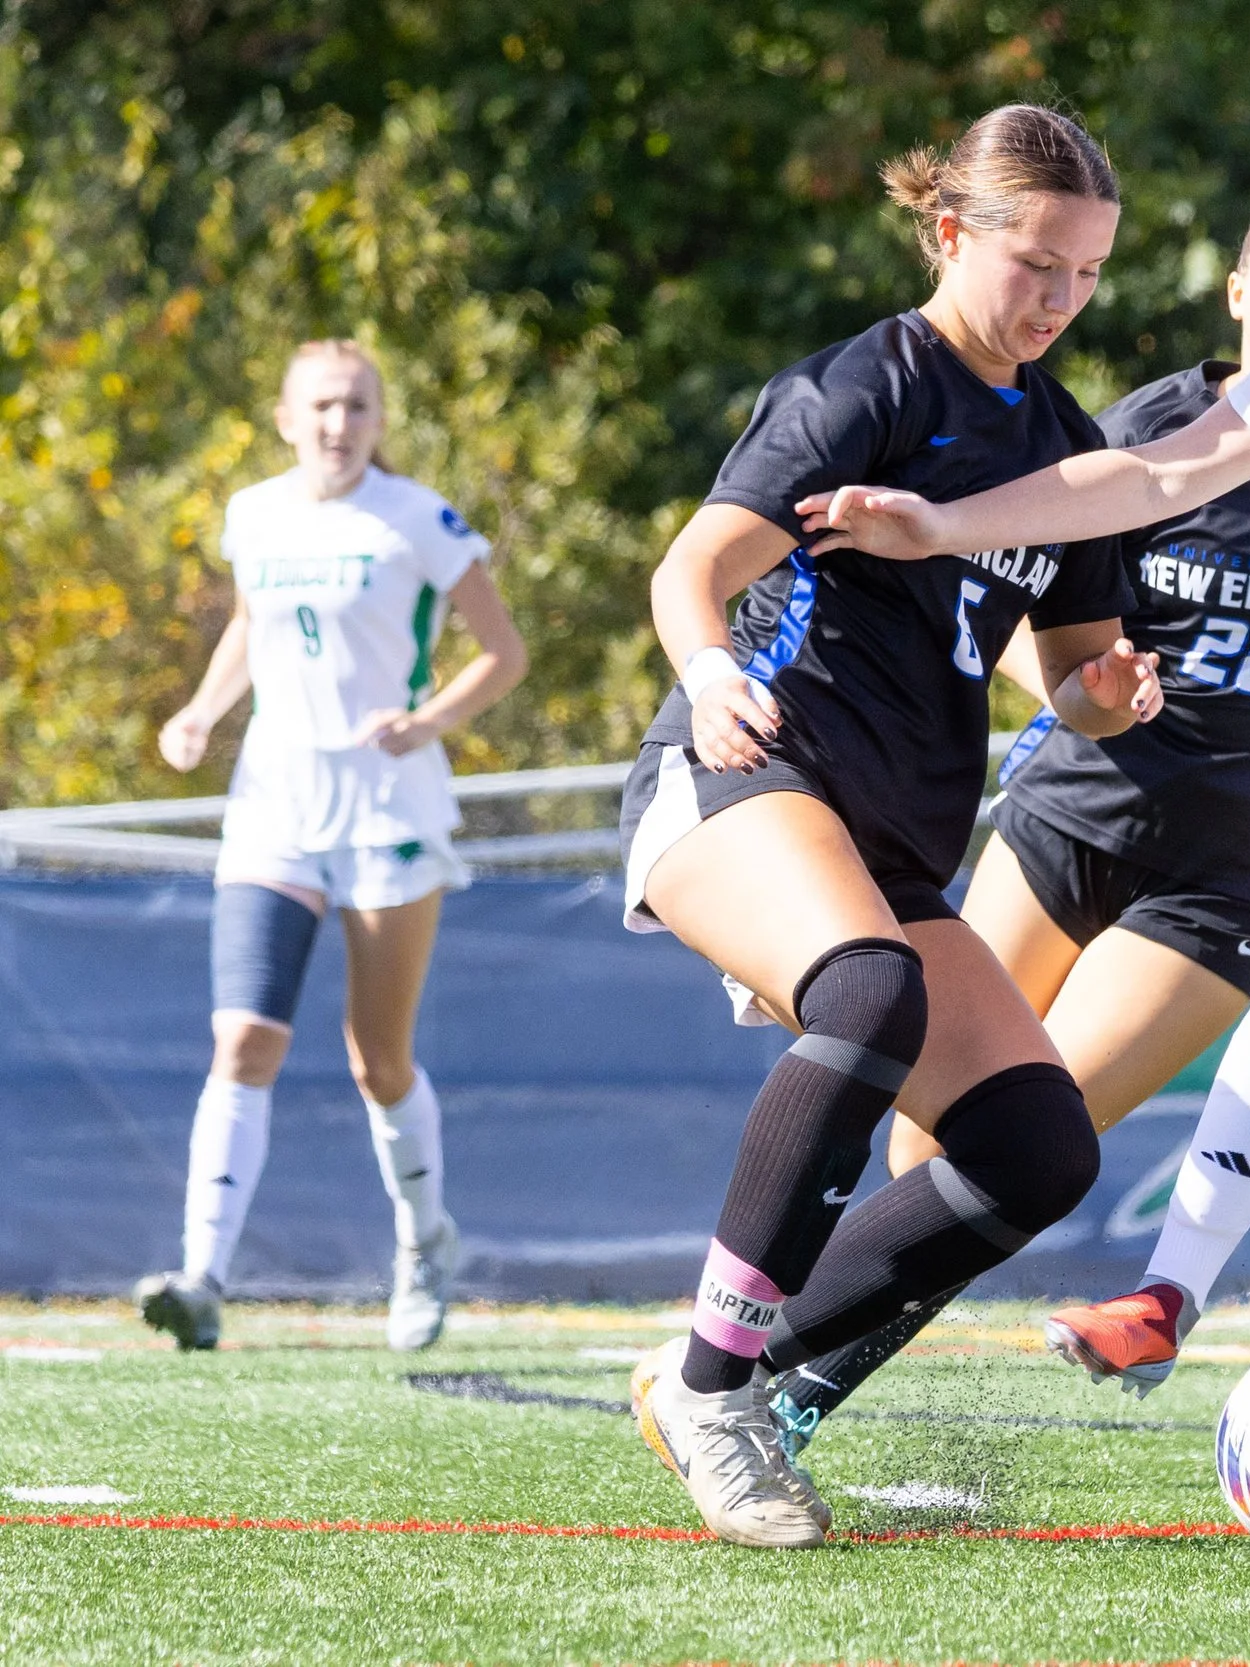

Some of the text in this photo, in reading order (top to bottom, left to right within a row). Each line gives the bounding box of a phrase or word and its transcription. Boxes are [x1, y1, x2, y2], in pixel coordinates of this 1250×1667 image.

[1140, 552, 1216, 603] NEW
[297, 603, 322, 657] 9
[706, 1281, 778, 1328] CAPTAIN
